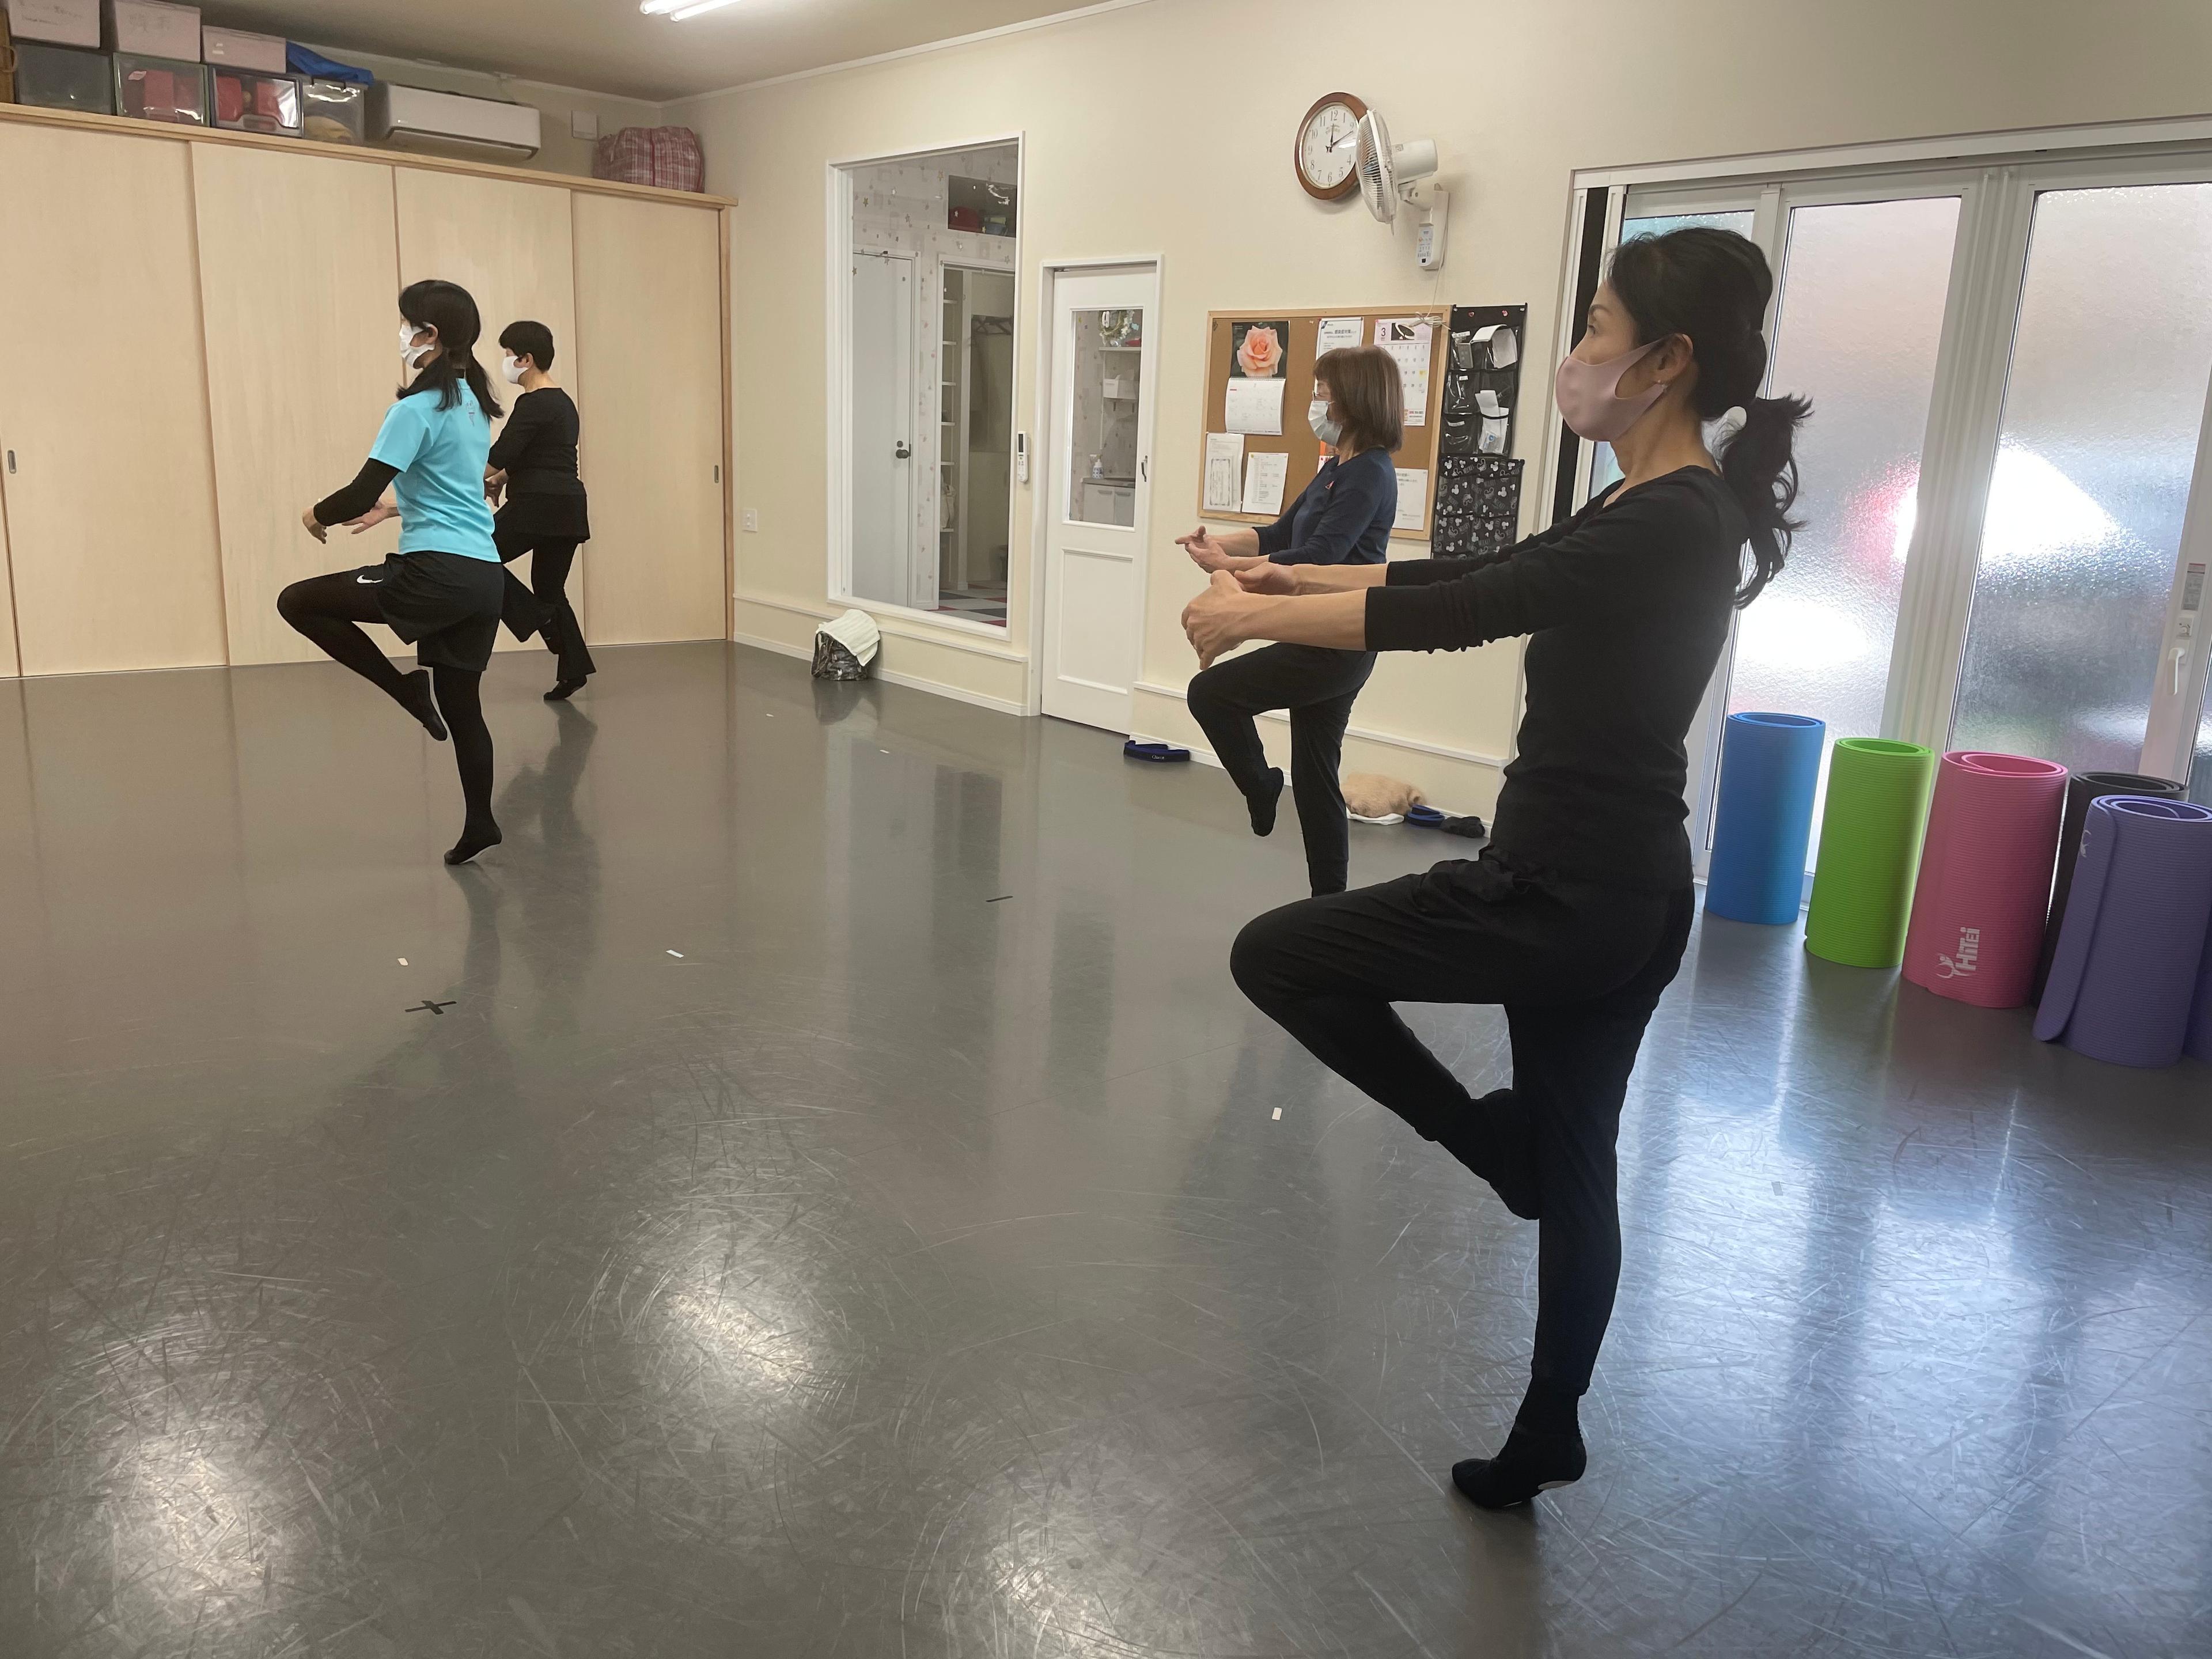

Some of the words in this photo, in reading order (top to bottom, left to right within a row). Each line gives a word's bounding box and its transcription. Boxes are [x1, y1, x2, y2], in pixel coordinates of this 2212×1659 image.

[1331, 109, 1338, 121] 12
[1343, 112, 1346, 123] 1
[1320, 115, 1325, 127] 11
[1312, 128, 1319, 139] 10
[1308, 145, 1313, 156] 9
[1347, 154, 1351, 165] 4
[1310, 160, 1315, 171] 8
[1317, 169, 1322, 180] 7
[1327, 171, 1332, 183] 6
[1338, 166, 1343, 178] 5
[1381, 327, 1386, 336] 3
